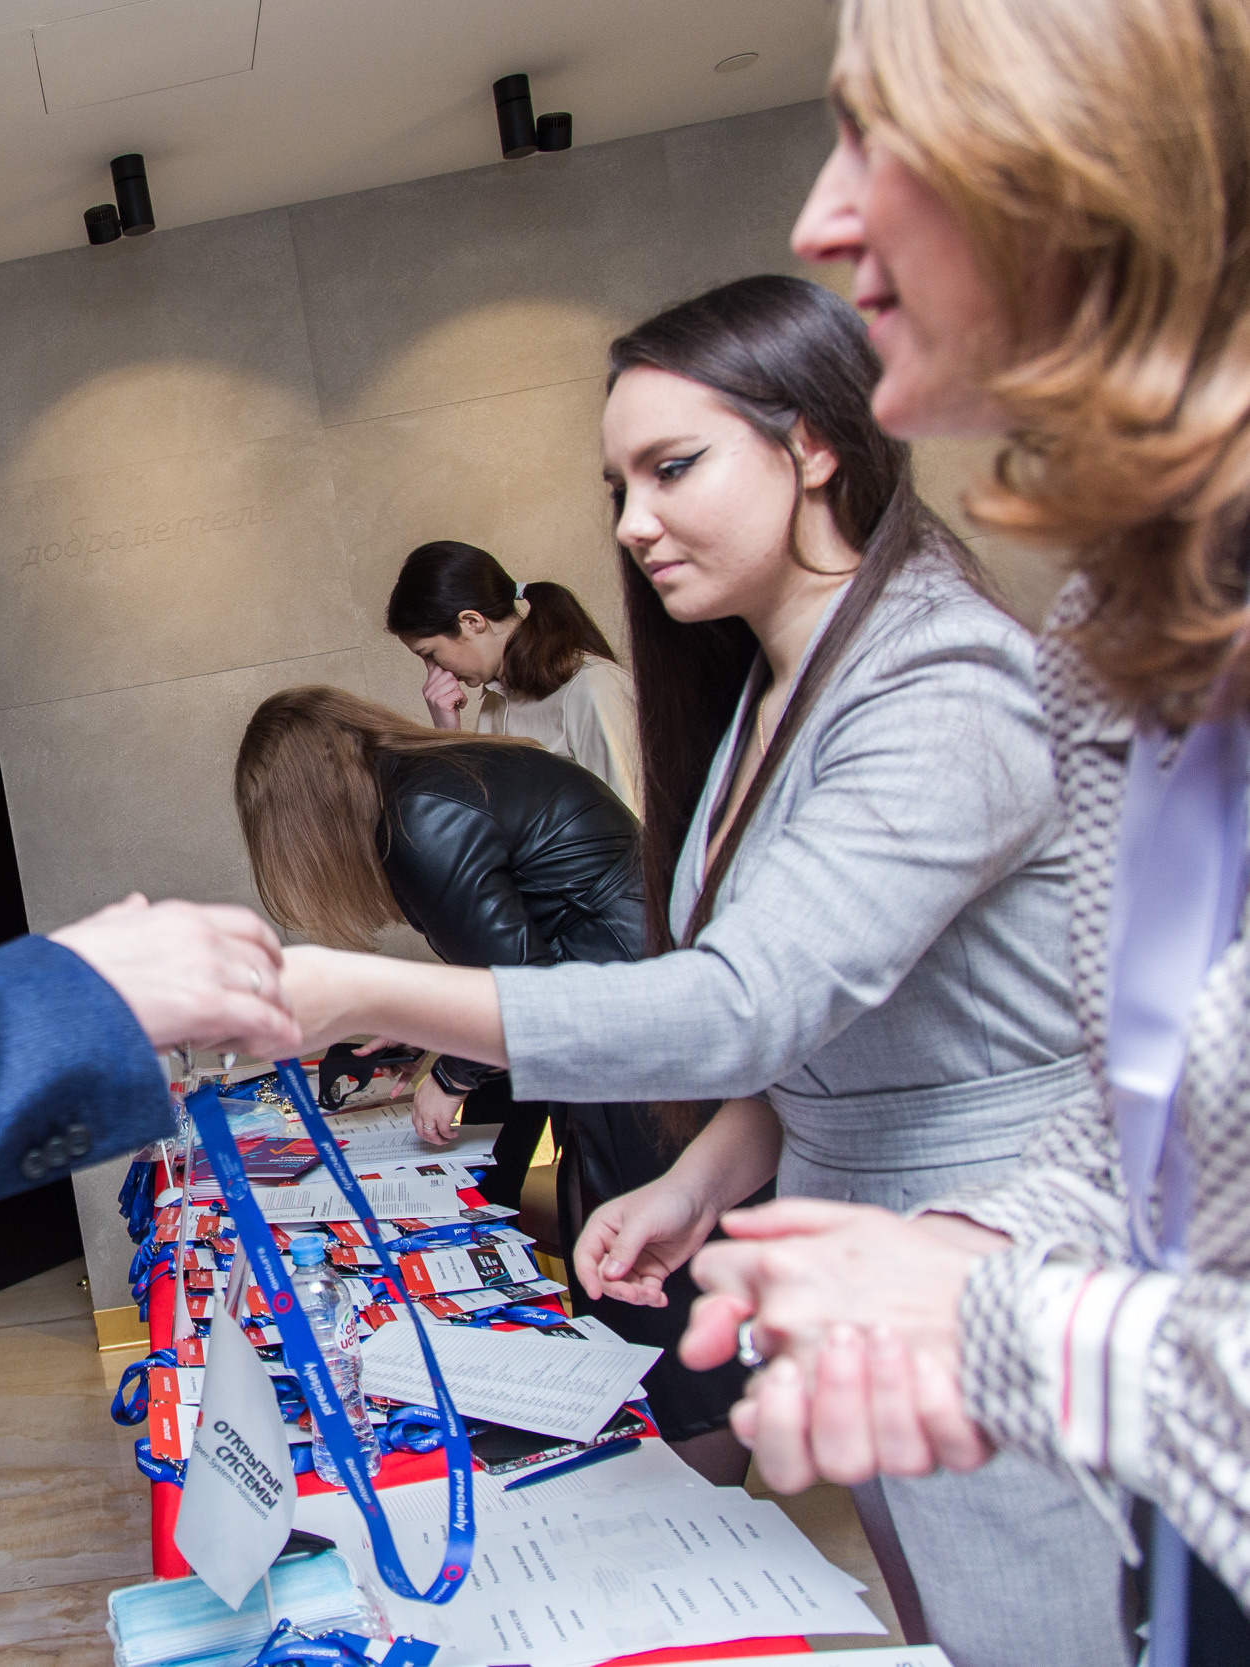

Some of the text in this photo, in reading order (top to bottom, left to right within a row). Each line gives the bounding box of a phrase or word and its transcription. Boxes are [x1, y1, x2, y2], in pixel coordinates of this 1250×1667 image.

[319, 1141, 354, 1192] precisely
[303, 1361, 337, 1416] precisely
[193, 1440, 270, 1521] Open Systems Publications
[213, 1420, 284, 1496] ОТКРЫТЫЕ
[215, 1445, 278, 1510] СИСТЕМЫ
[345, 1456, 372, 1504] ataccama
[452, 1468, 470, 1532] precisely
